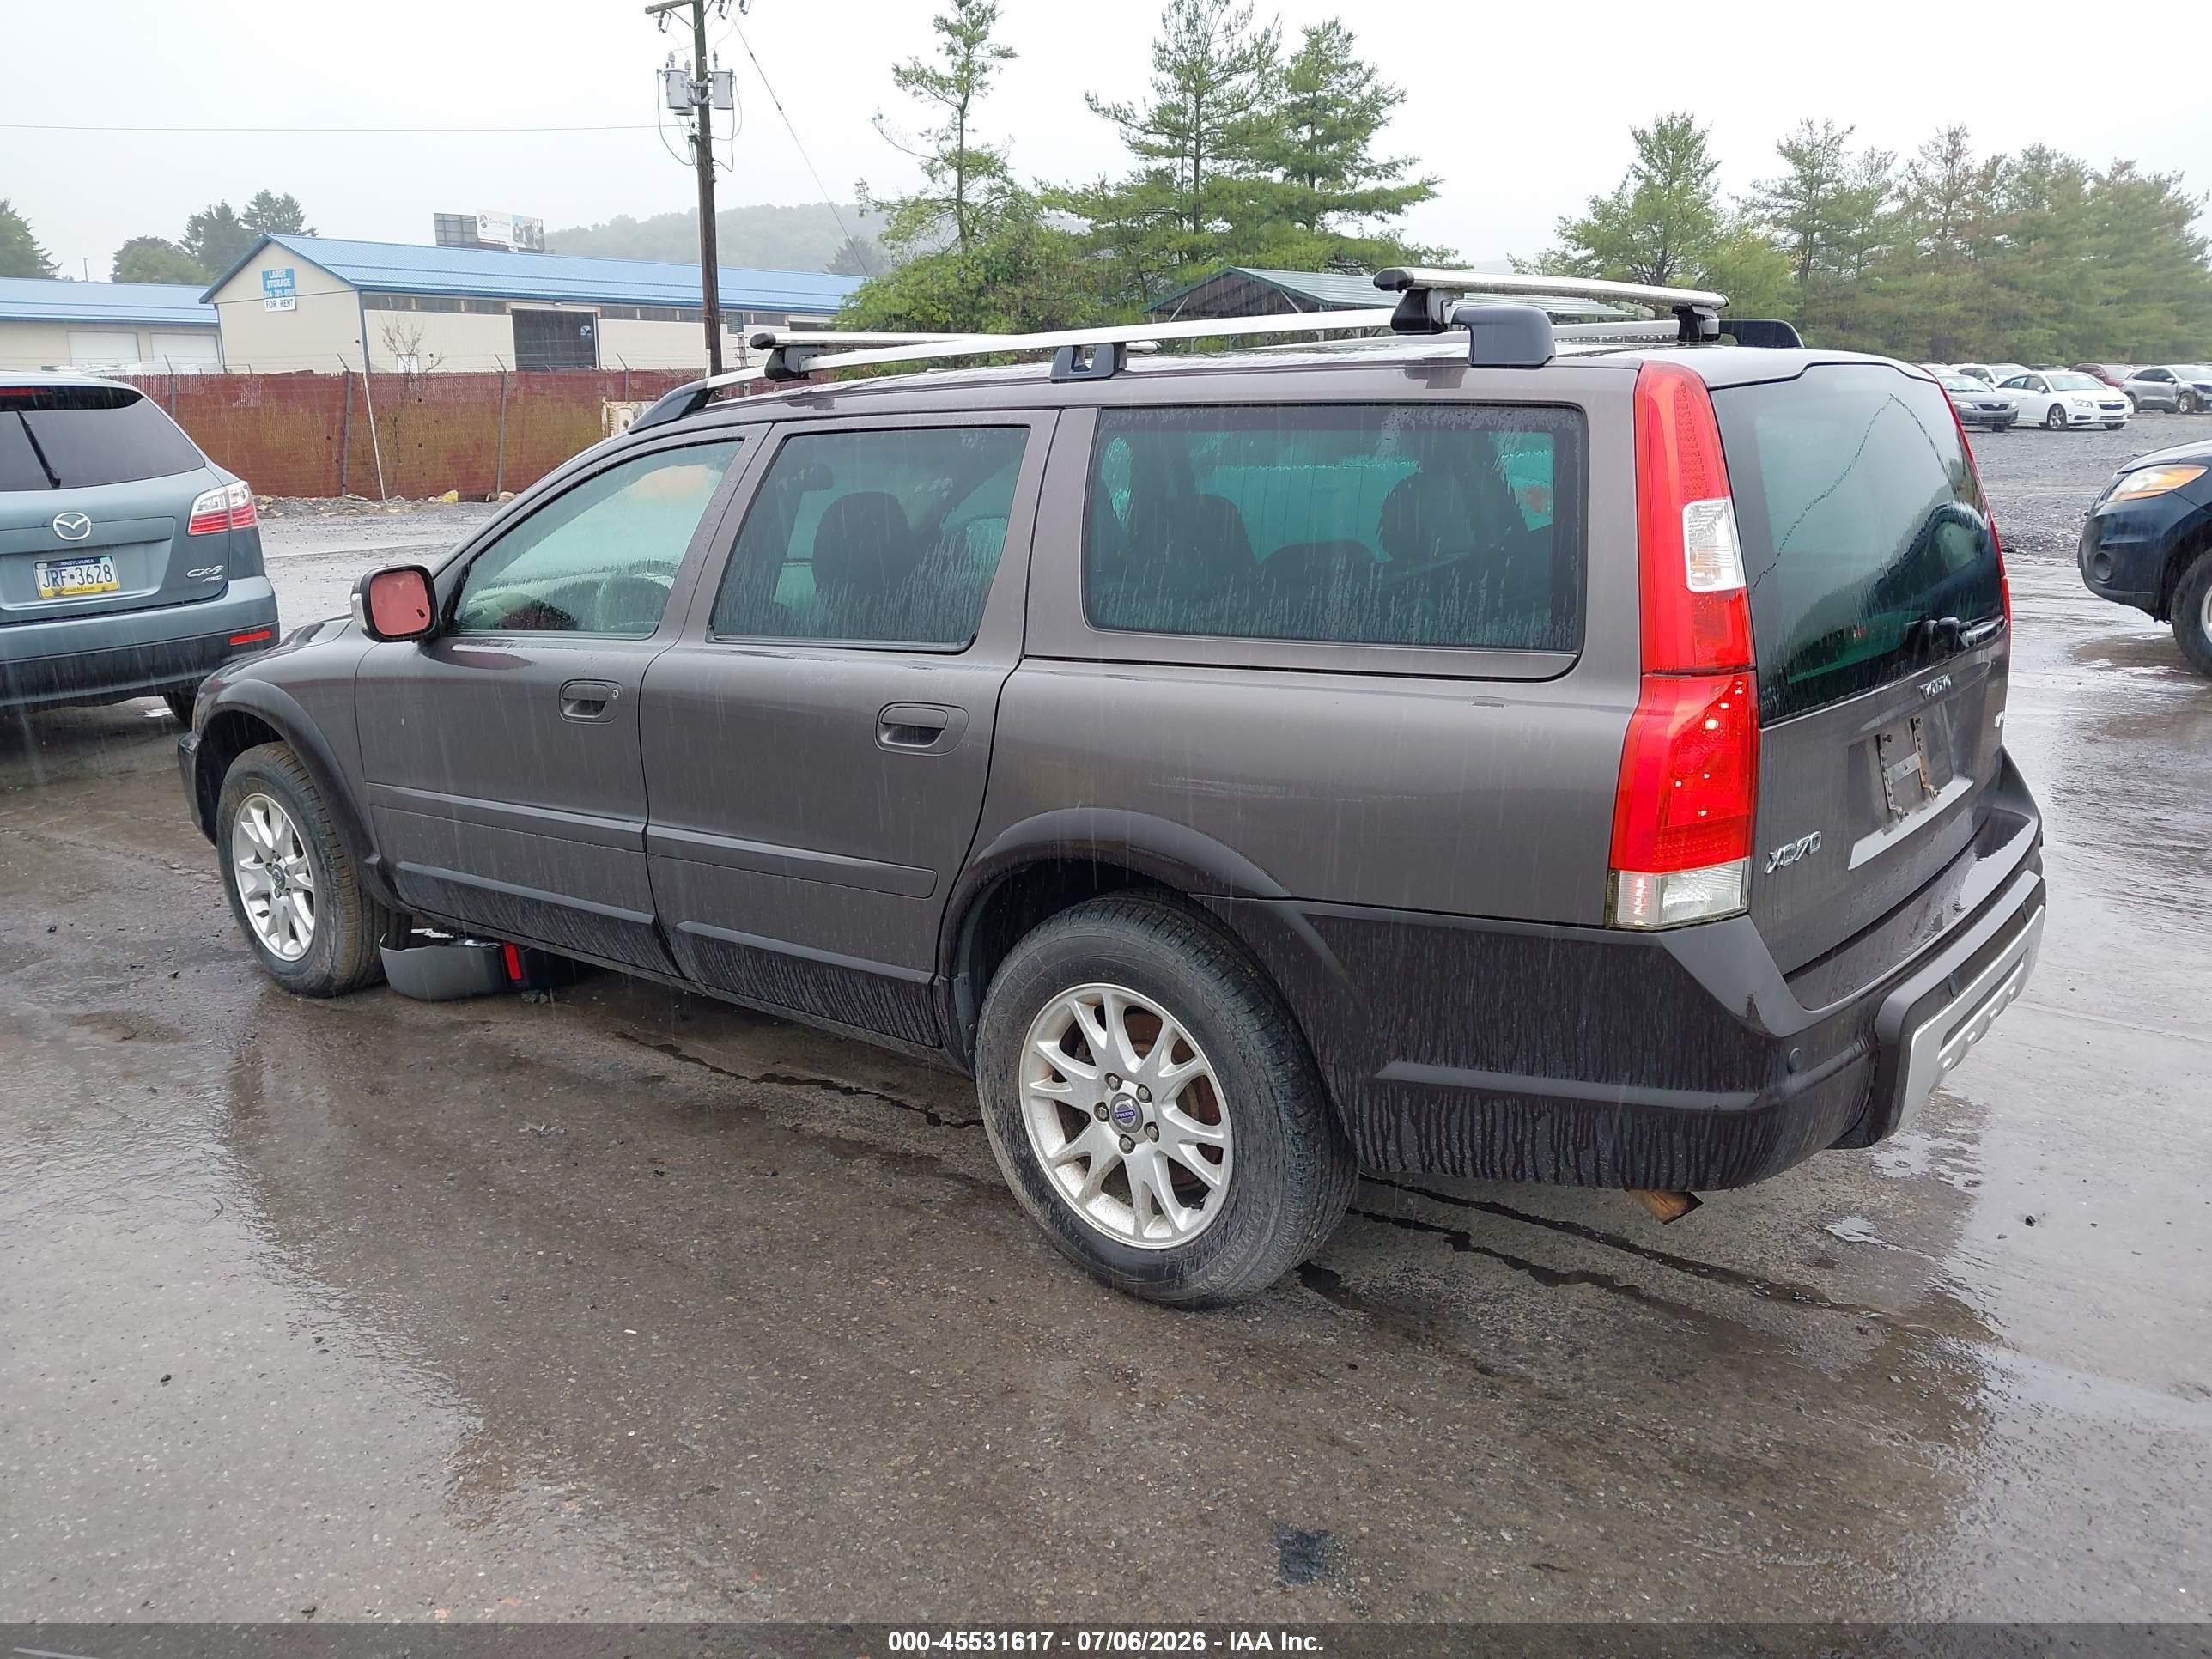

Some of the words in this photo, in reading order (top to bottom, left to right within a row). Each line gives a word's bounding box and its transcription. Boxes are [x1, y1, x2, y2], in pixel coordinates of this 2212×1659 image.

[266, 277, 292, 289] STORAGE
[266, 300, 277, 309] FOR
[279, 298, 294, 307] RENT
[1764, 830, 1822, 874] XC70
